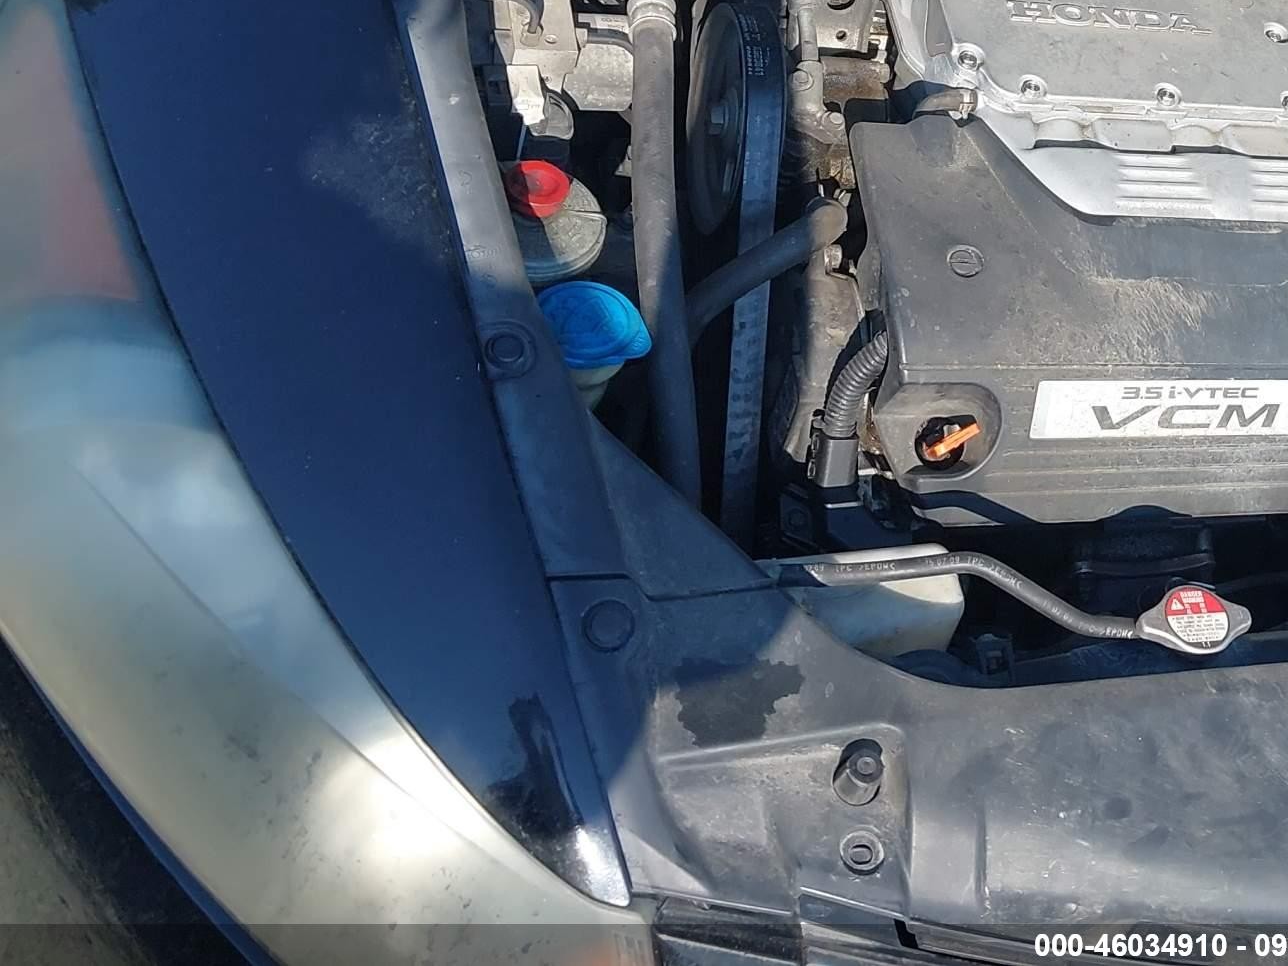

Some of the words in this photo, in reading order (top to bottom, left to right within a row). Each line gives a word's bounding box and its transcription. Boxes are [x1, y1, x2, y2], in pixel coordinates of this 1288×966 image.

[1006, 0, 1213, 35] HONDA
[1122, 386, 1164, 400] 3.5
[1169, 386, 1260, 399] i-VTEC
[1091, 403, 1281, 430] VCM
